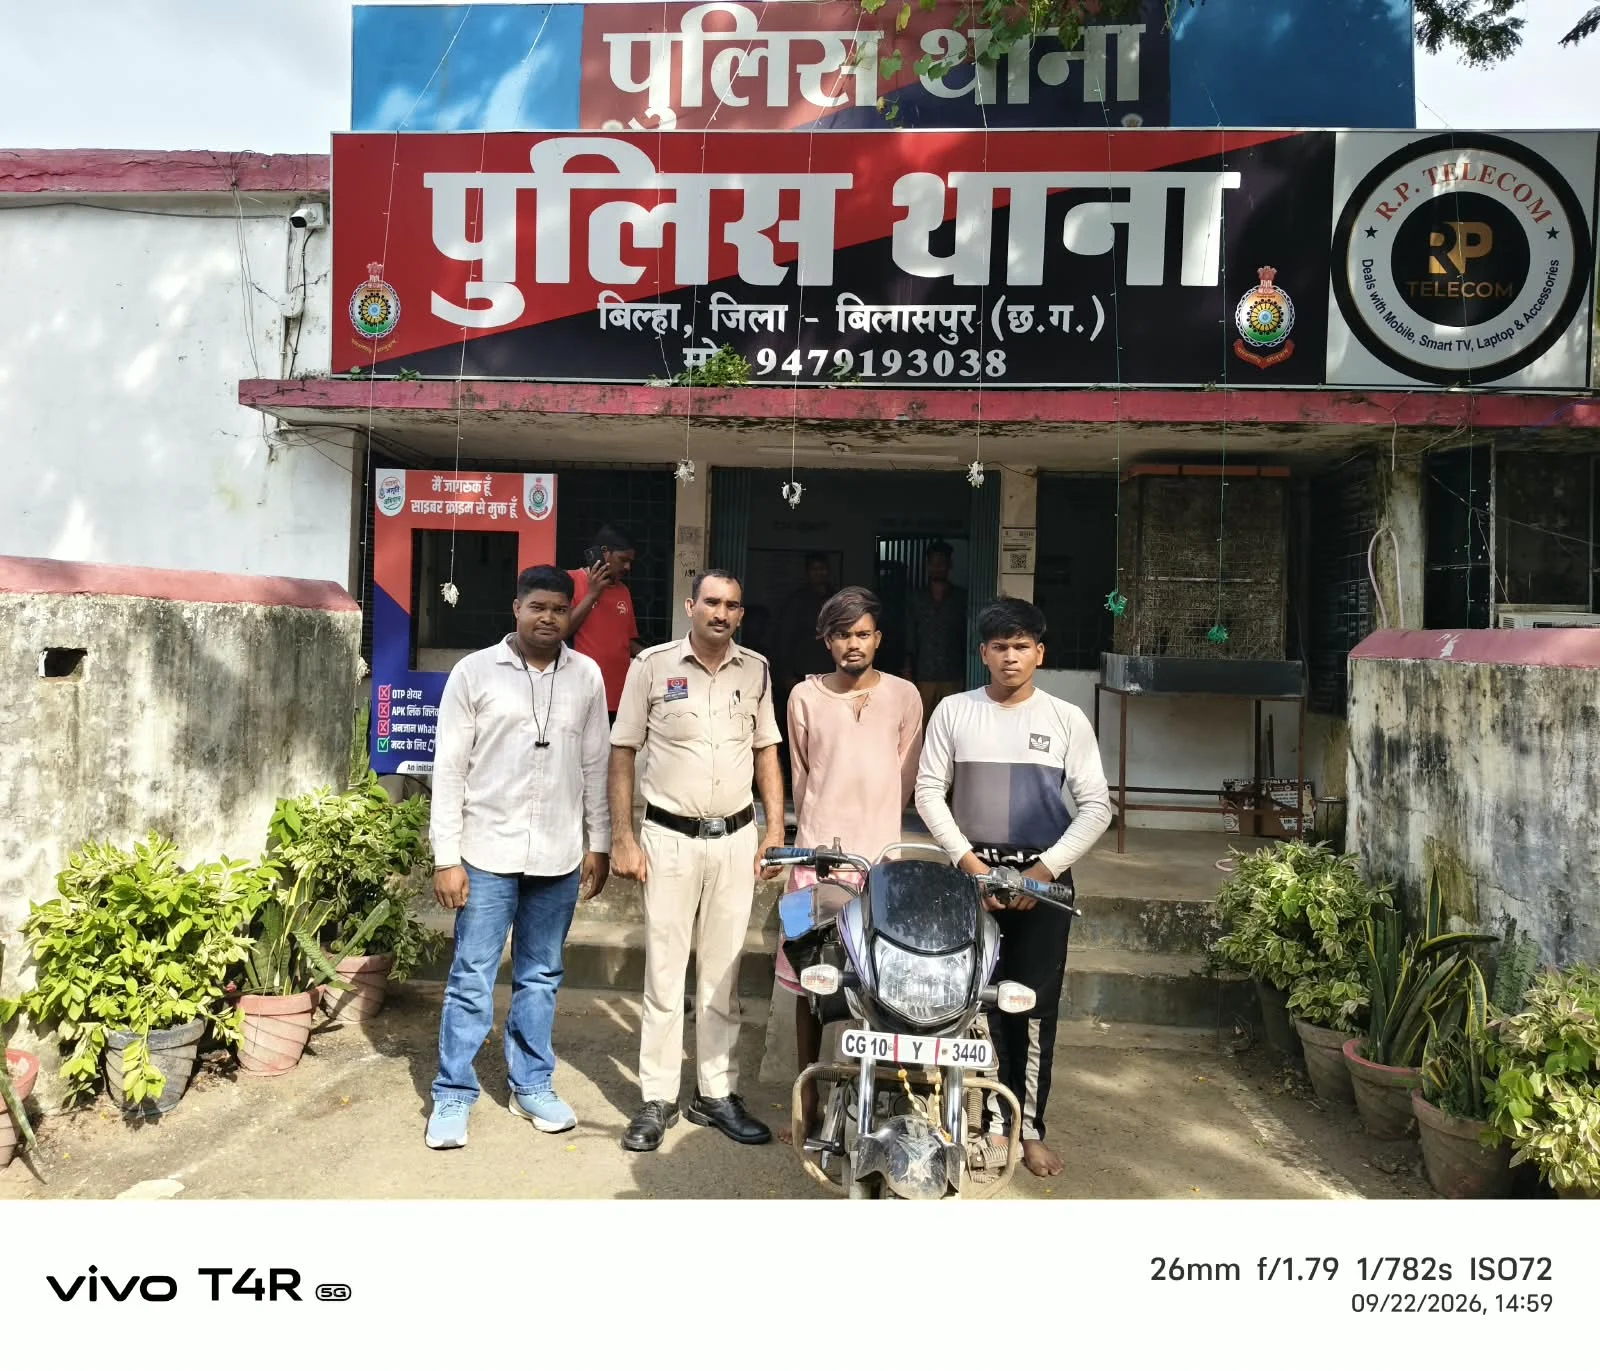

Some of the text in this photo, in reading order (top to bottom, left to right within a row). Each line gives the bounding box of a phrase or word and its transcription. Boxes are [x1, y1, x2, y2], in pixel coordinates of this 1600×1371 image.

[603, 3, 1146, 129] पुलिस थाना
[1375, 162, 1553, 223] R.P. TELECOM
[424, 137, 1241, 328] पुलिस थाना
[1407, 282, 1513, 298] TELECOM
[709, 292, 788, 333] जिला
[836, 291, 976, 343] बिलासपुर
[991, 295, 1106, 341] (छ.ग.)
[1361, 258, 1560, 353] Deals with Mobile, Smart TV, Laptop & Accessories
[756, 347, 1007, 377] 9479193038
[432, 474, 493, 496] मैं जागरूक हूँ
[410, 499, 443, 514] साइबर
[445, 500, 474, 515] क्राइम
[475, 498, 485, 514] से
[487, 502, 507, 519] मुक्त
[508, 498, 518, 518] हूँ
[392, 688, 422, 700] OTP शेयर
[391, 706, 405, 716] APK
[406, 704, 421, 716] लिंक
[391, 723, 416, 733] अनजान
[391, 738, 427, 750] मदद के लिए
[845, 1034, 986, 1062] CG 10 Y 3440
